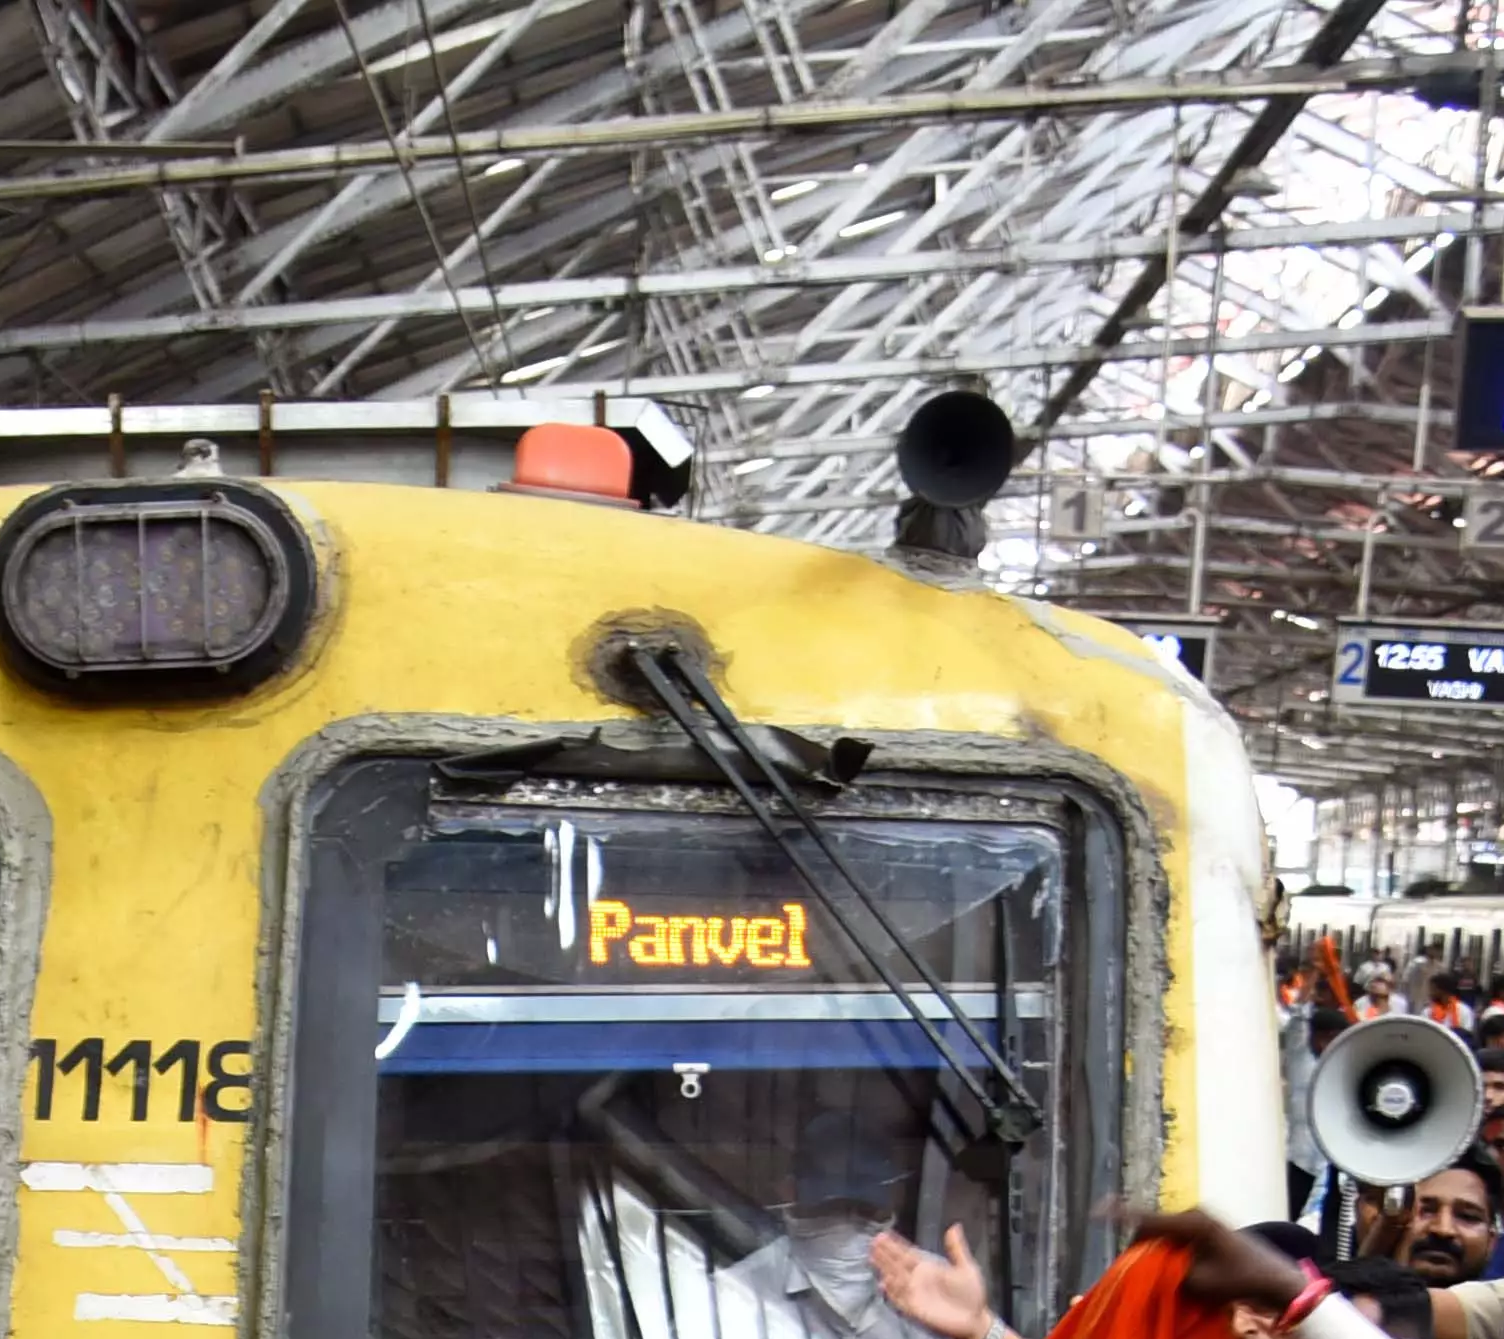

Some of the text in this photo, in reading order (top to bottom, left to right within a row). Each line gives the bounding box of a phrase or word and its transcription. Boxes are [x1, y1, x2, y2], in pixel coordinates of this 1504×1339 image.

[1338, 641, 1365, 686] 2
[589, 900, 812, 968] Panvel
[29, 1037, 254, 1123] 11118
